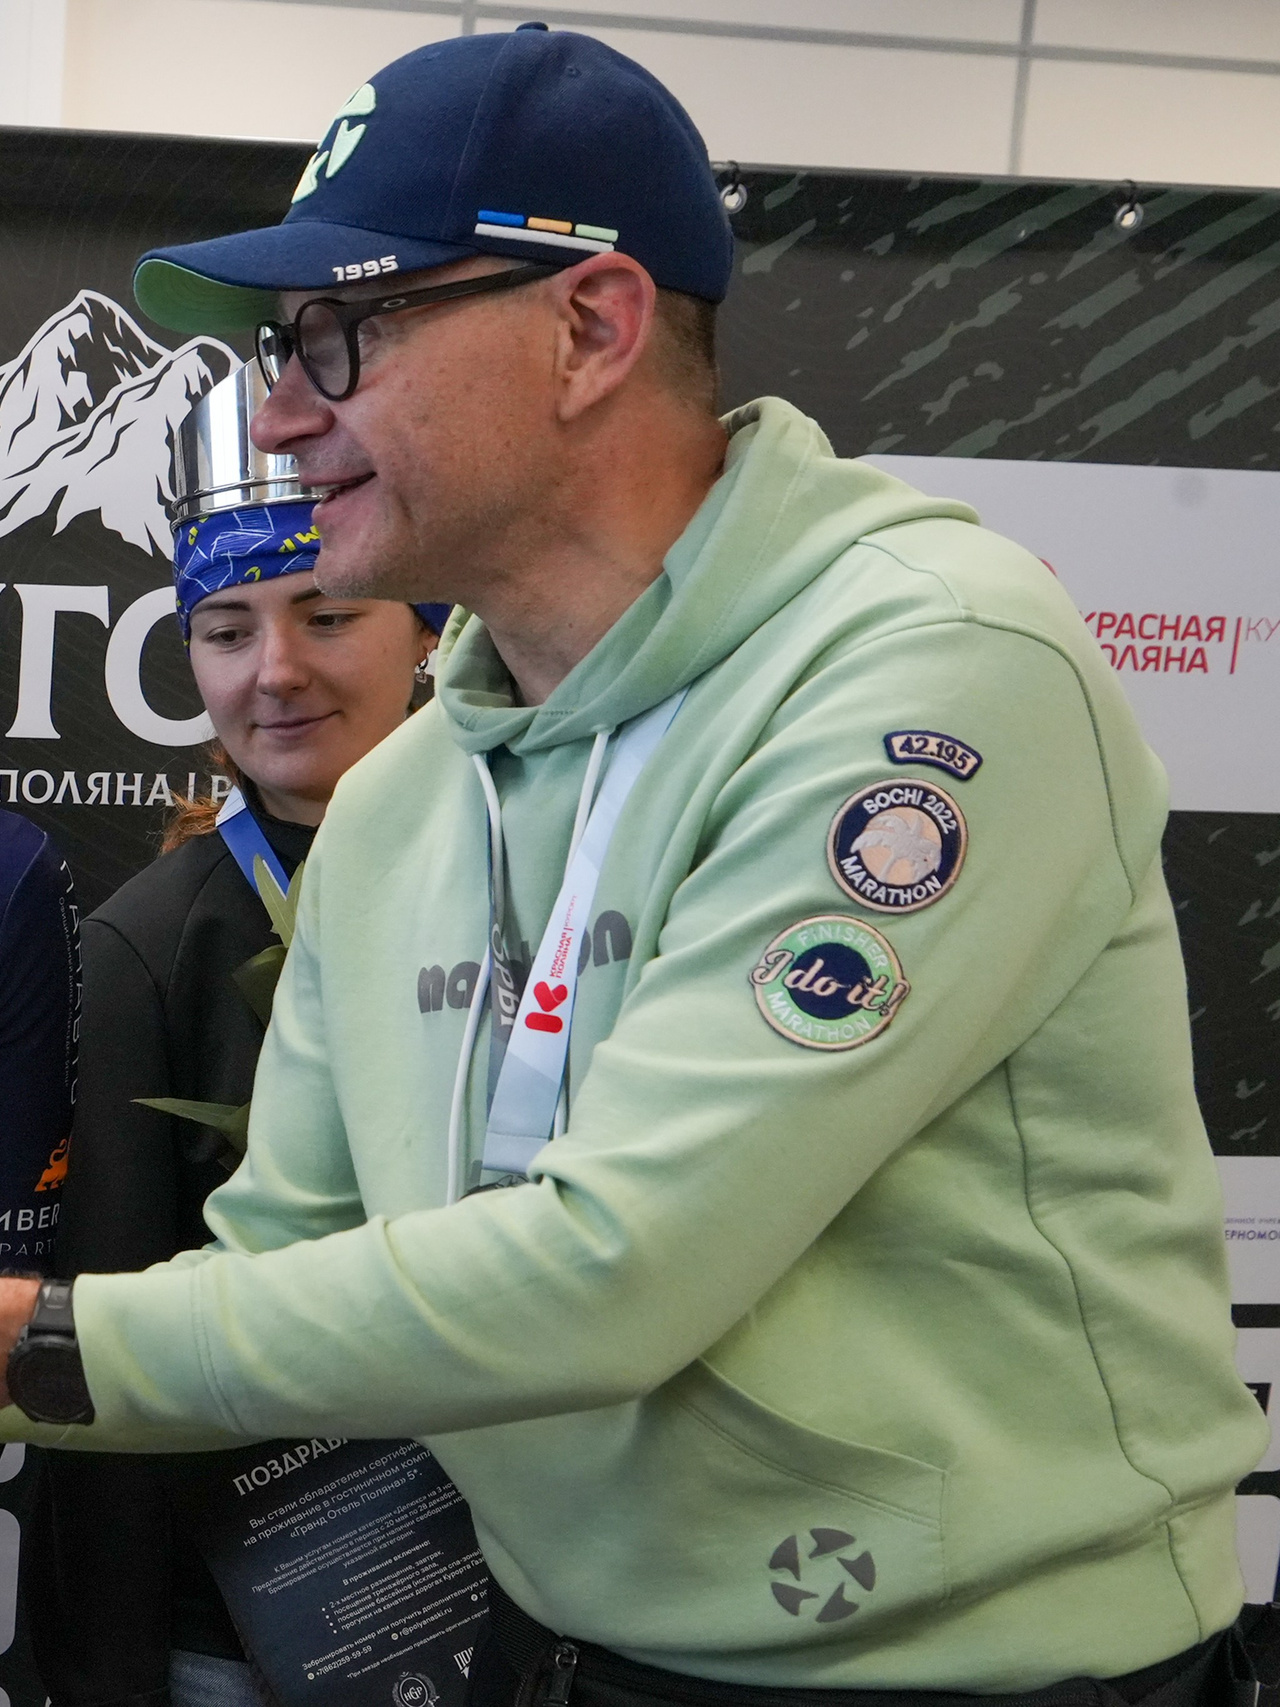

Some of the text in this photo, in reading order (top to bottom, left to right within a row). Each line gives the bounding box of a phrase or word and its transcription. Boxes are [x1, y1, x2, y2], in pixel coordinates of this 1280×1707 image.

[332, 255, 399, 282] 1995
[1080, 610, 1227, 643] РАСНАЯ
[1100, 643, 1209, 674] ЛЯНА
[898, 736, 969, 771] 42.195
[862, 786, 958, 835] SOCHI 2022
[840, 855, 943, 905] MARATHON
[549, 931, 568, 978] КРАСНАЯ
[555, 936, 572, 979] ПОЛЯНА
[796, 923, 889, 969] FINISHER
[783, 957, 849, 997] do
[766, 990, 872, 1042] MARATHON
[232, 1437, 348, 1497] ПОЗДРАВ
[243, 1535, 257, 1547] на
[257, 1502, 322, 1541] проживание
[322, 1499, 330, 1507] в
[331, 1464, 399, 1504] гостиничном
[248, 1514, 266, 1529] Вы
[266, 1500, 297, 1520] стали
[297, 1464, 367, 1506] обладателем
[288, 1513, 327, 1540] «Гранд
[326, 1497, 361, 1521] Отель
[360, 1474, 406, 1504] Поляна»
[279, 1554, 303, 1570] Вашим
[303, 1541, 332, 1560] услугам
[332, 1529, 358, 1545] номера
[357, 1511, 394, 1534] категории
[427, 1489, 437, 1498] на
[251, 1565, 298, 1594] Предложение
[297, 1541, 348, 1571] действительно
[353, 1526, 380, 1544] период
[384, 1519, 394, 1528] 20
[268, 1566, 317, 1595] Бронирование
[317, 1539, 372, 1571] осуществляется
[342, 1546, 379, 1568] указанной
[348, 1557, 393, 1584] проживание
[392, 1539, 431, 1562] включено:
[333, 1592, 372, 1616] посещение
[337, 1600, 376, 1624] посещение
[375, 1581, 412, 1605] бассейнов
[340, 1585, 370, 1603] местное
[341, 1611, 373, 1632] прогулки
[382, 1591, 415, 1611] канатных
[414, 1577, 443, 1595] дорогах
[442, 1562, 471, 1582] Курорта
[301, 1639, 354, 1671] Забронировать
[354, 1631, 376, 1647] номер
[390, 1608, 422, 1629] получить
[421, 1580, 479, 1614] дополнительную
